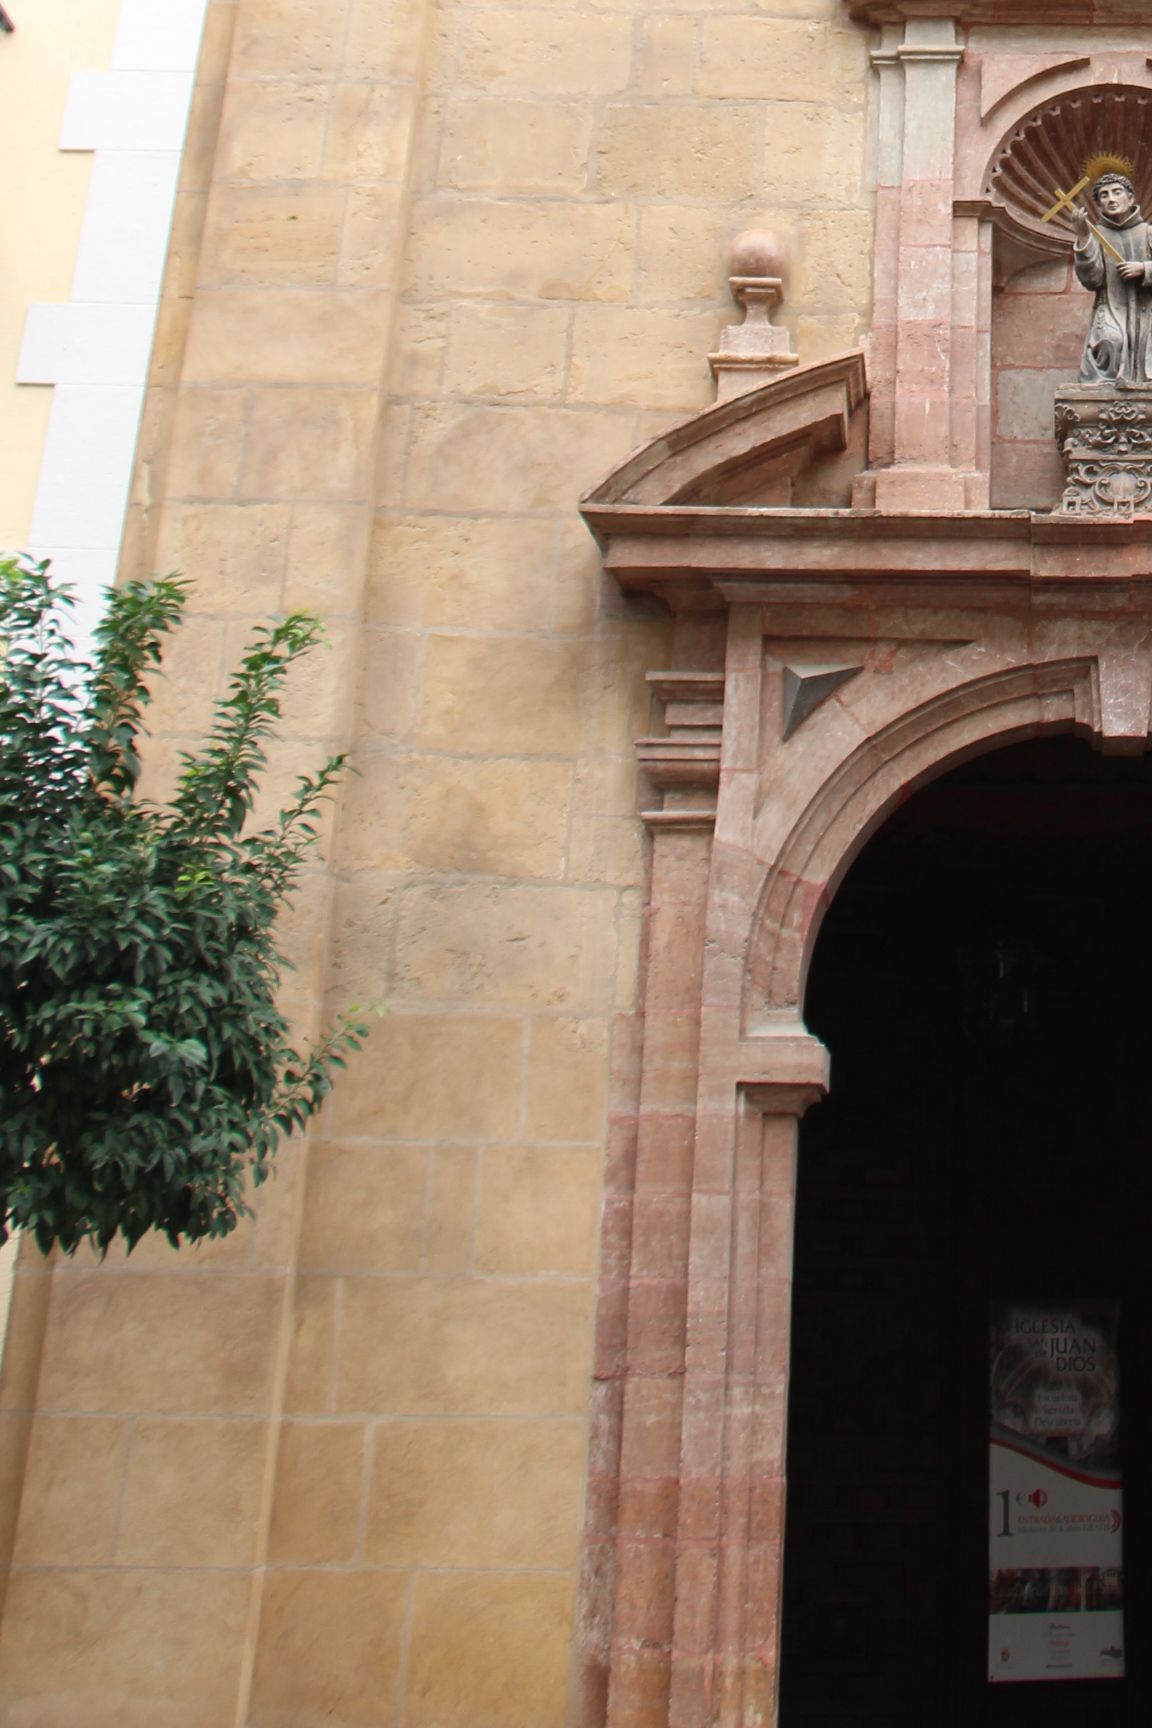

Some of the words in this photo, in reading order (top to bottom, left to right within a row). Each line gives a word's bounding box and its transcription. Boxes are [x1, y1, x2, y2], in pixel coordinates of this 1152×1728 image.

[1016, 1317, 1076, 1334] IGLESIA
[1050, 1337, 1096, 1358] JUAN
[1056, 1356, 1096, 1372] DIOS
